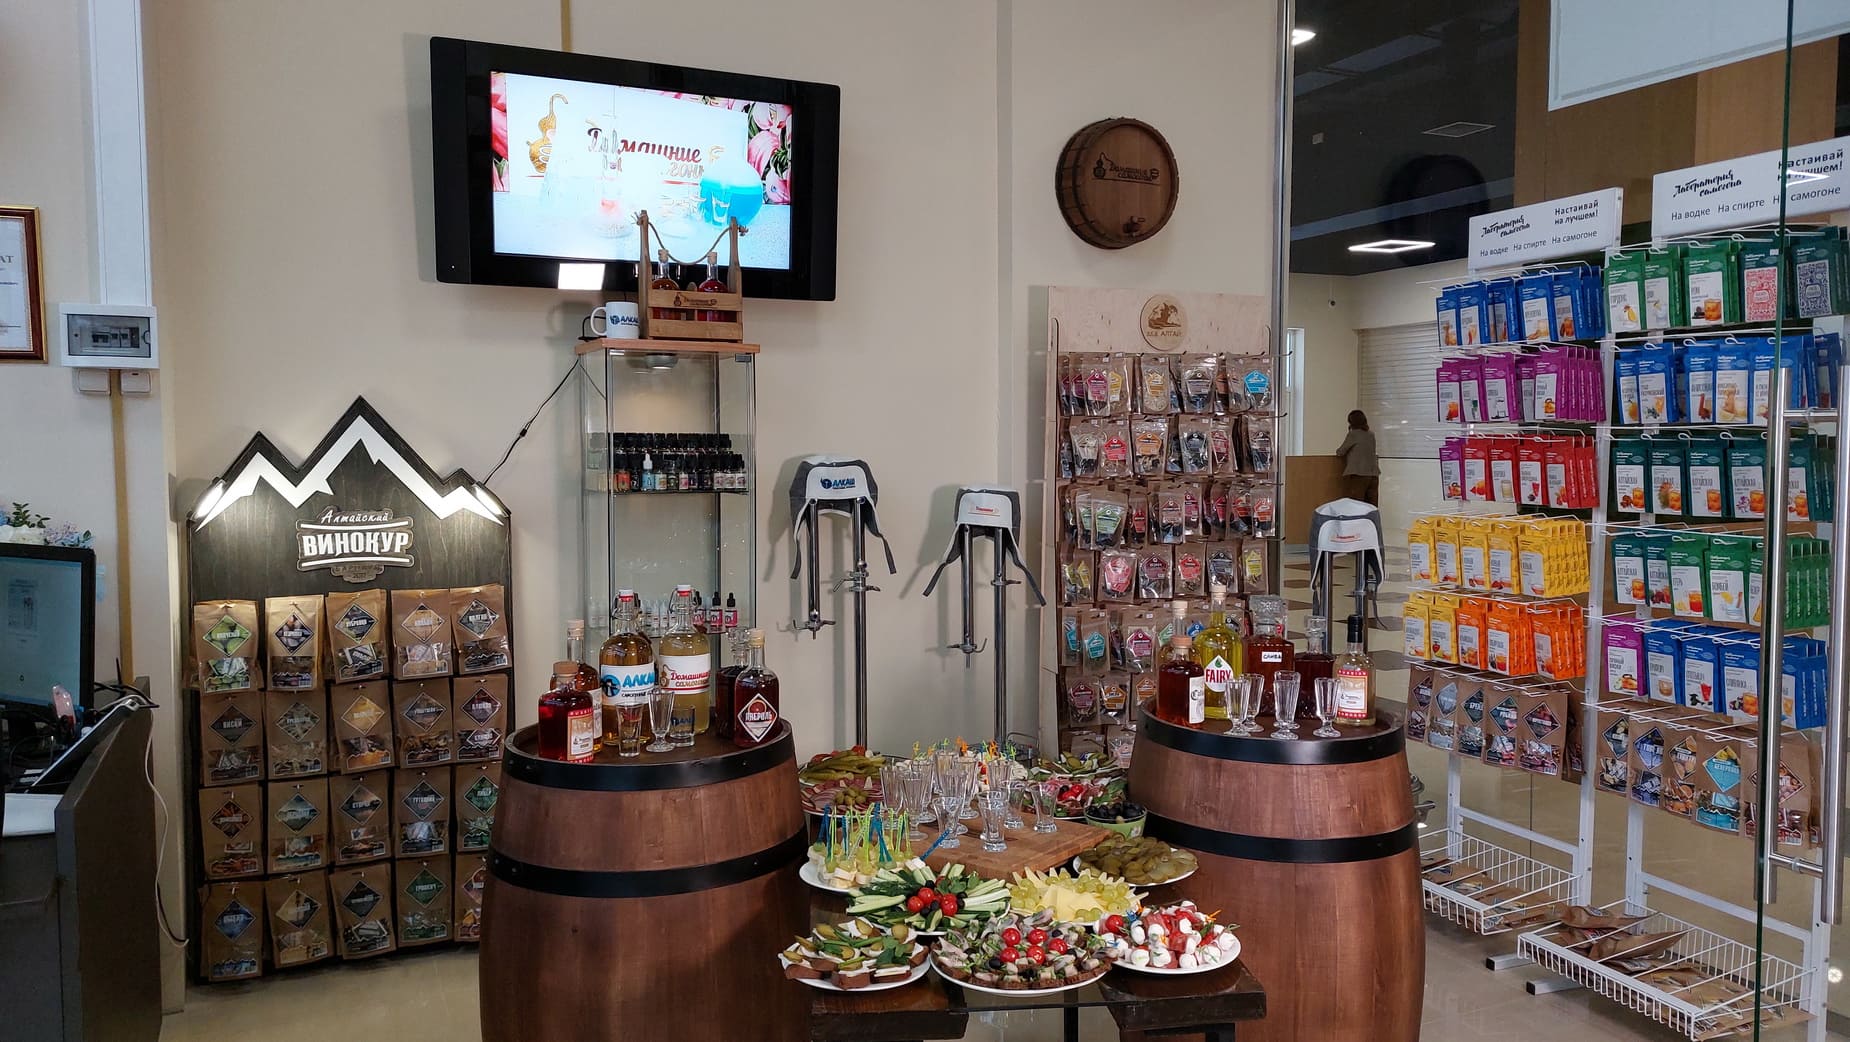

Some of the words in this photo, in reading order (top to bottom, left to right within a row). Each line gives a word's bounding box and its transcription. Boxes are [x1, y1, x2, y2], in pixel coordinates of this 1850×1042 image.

[1554, 200, 1599, 215] Настаивай
[1671, 212, 1682, 220] На
[1685, 208, 1710, 218] водке
[1718, 204, 1730, 213] На
[1732, 199, 1765, 211] спирте
[1790, 186, 1841, 202] самогоне
[1565, 209, 1598, 223] лучшем!
[1480, 249, 1489, 257] На
[1490, 246, 1508, 255] водке
[1513, 243, 1522, 251] На
[1523, 239, 1546, 250] спирте
[1551, 236, 1561, 244] На
[1562, 230, 1598, 243] самогоне
[321, 510, 389, 523] Алтайский
[302, 532, 409, 556] ВИНОКУР
[1206, 668, 1231, 683] FAIRY
